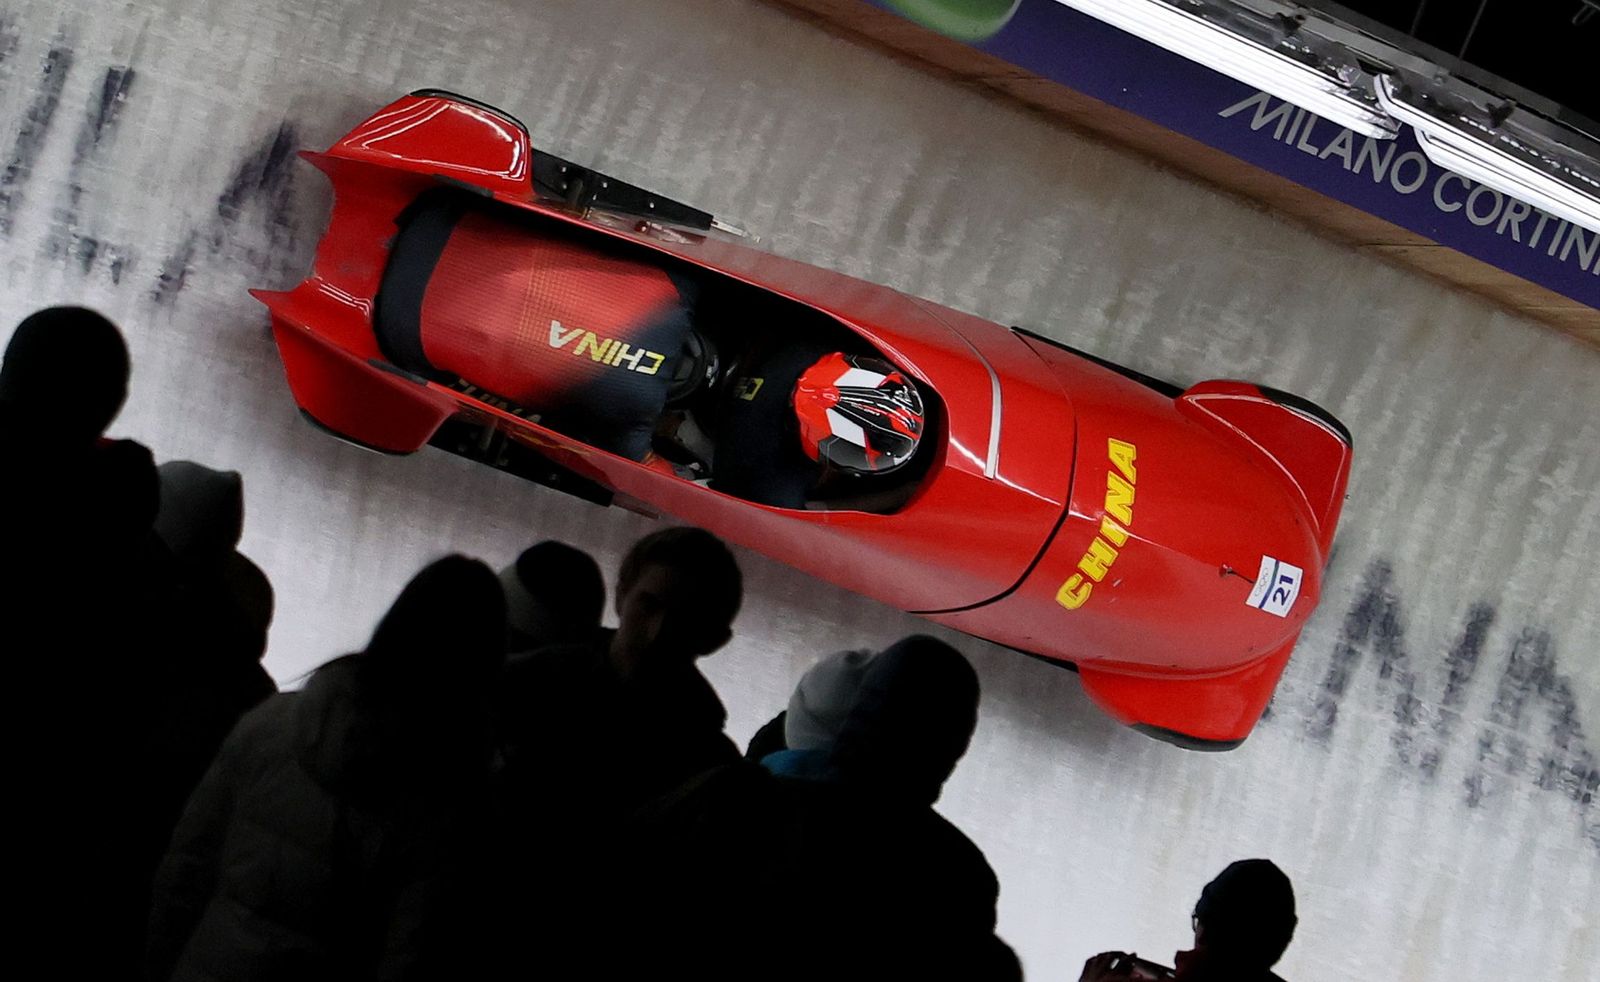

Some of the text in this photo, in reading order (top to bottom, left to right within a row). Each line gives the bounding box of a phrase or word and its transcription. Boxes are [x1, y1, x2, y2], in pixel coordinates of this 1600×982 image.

[1218, 91, 1600, 275] MILANO CORTIN
[549, 319, 666, 375] CHINA
[1056, 437, 1137, 610] CHINA
[1272, 574, 1294, 606] 21
